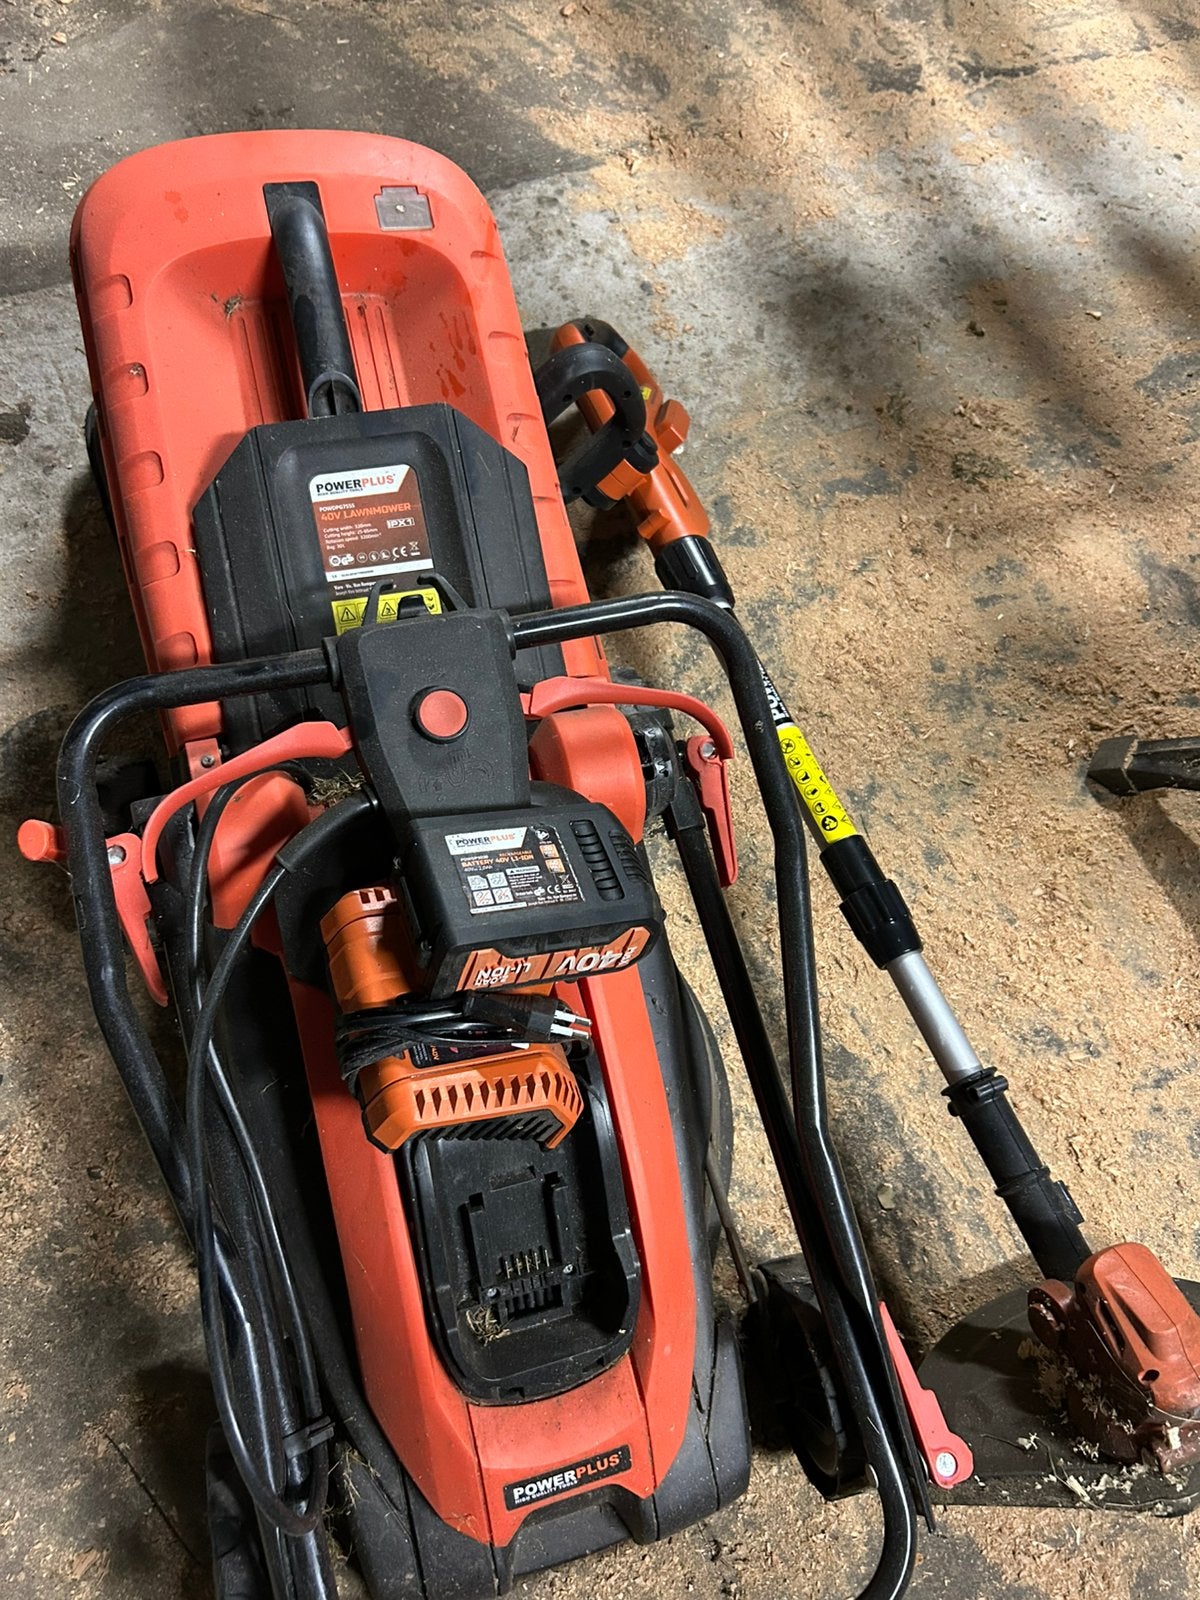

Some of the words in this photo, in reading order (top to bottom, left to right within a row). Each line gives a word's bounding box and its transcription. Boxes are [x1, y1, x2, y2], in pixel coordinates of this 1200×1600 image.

[316, 475, 395, 493] POWERPLUS
[320, 511, 341, 521] 40V
[343, 502, 411, 519] LAWNMOWER
[456, 833, 515, 846] POWERPLUS
[461, 859, 494, 868] BATTERY
[495, 856, 510, 864] 40V
[476, 962, 531, 979] LI-ION
[554, 950, 625, 973] 40V
[474, 974, 509, 986] 2.0Ah
[513, 1454, 620, 1500] POWERPLUS
[532, 1487, 558, 1500] QUALITY
[558, 1480, 578, 1490] TOOLS
